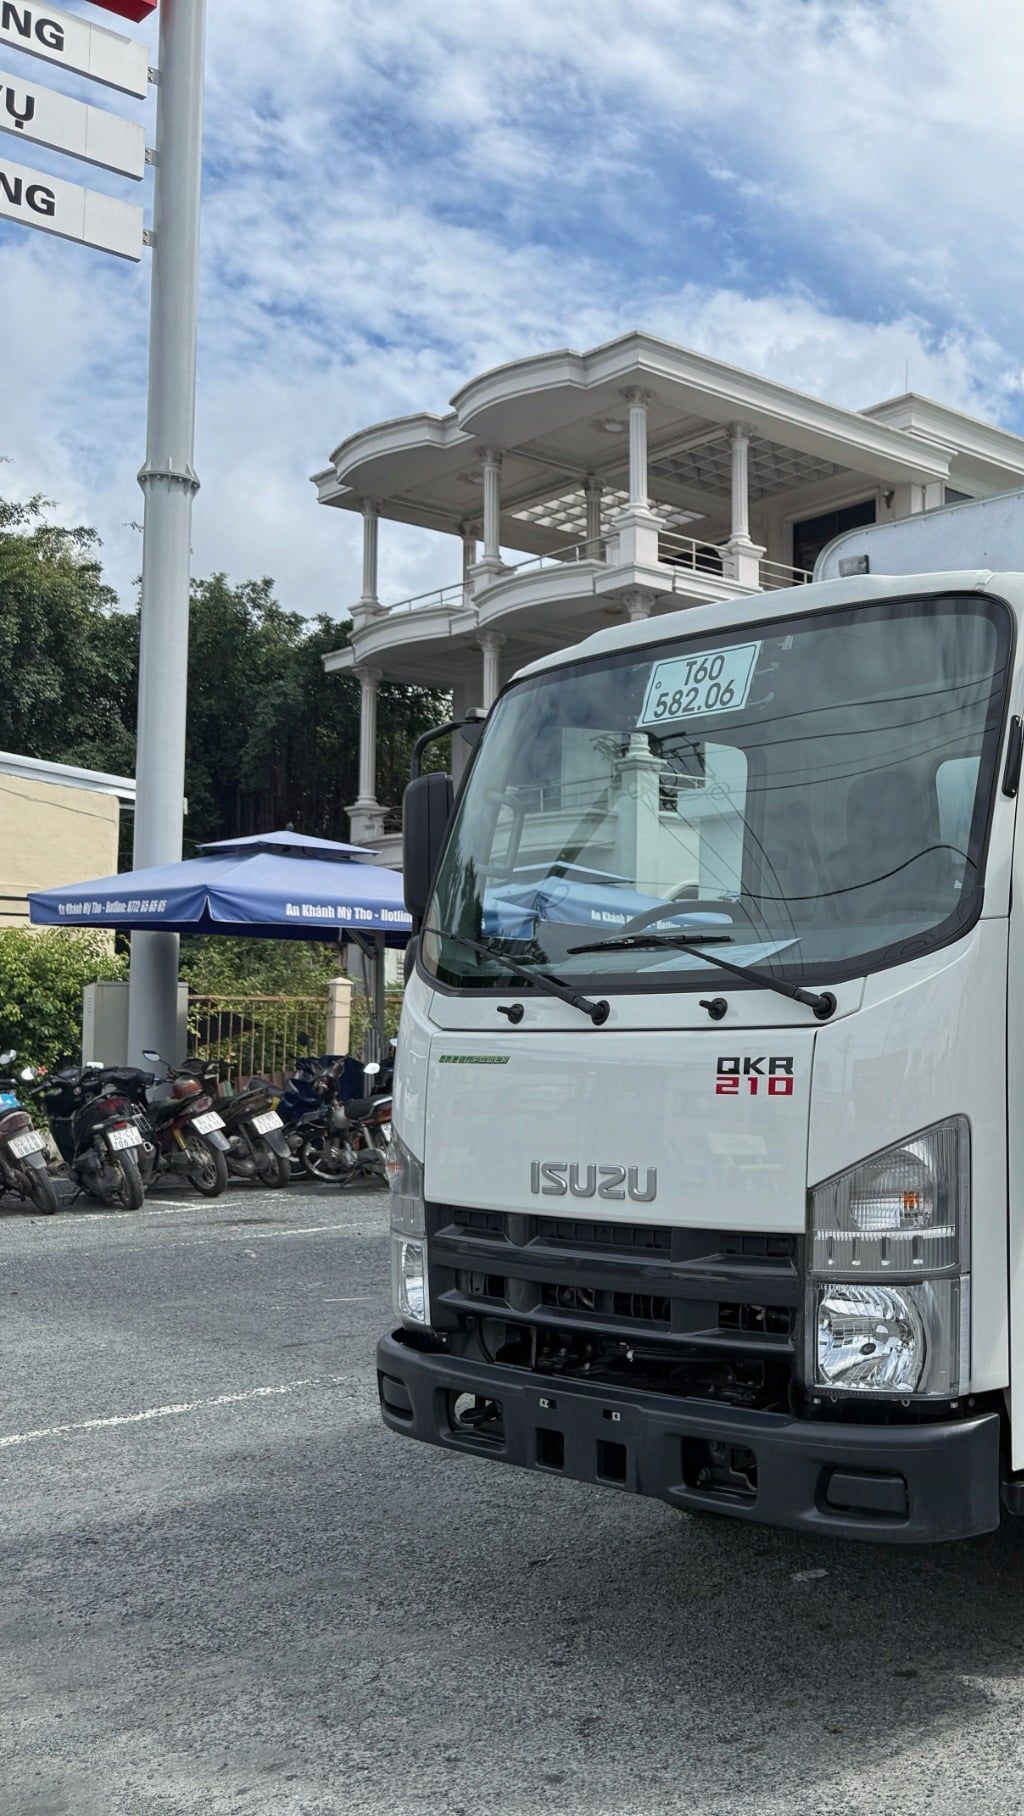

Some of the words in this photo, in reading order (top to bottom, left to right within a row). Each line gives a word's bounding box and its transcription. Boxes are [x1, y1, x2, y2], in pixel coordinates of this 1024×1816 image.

[1, 2, 64, 51] NG
[0, 85, 35, 129] Ụ
[0, 172, 55, 216] NG
[684, 655, 725, 686] T60
[654, 680, 734, 718] 582.06
[286, 904, 300, 916] An
[302, 904, 335, 918] Khánh
[354, 907, 372, 920] Tho
[717, 1057, 793, 1075] QKR
[716, 1077, 793, 1095] 210
[530, 1160, 657, 1201] ISUZU
